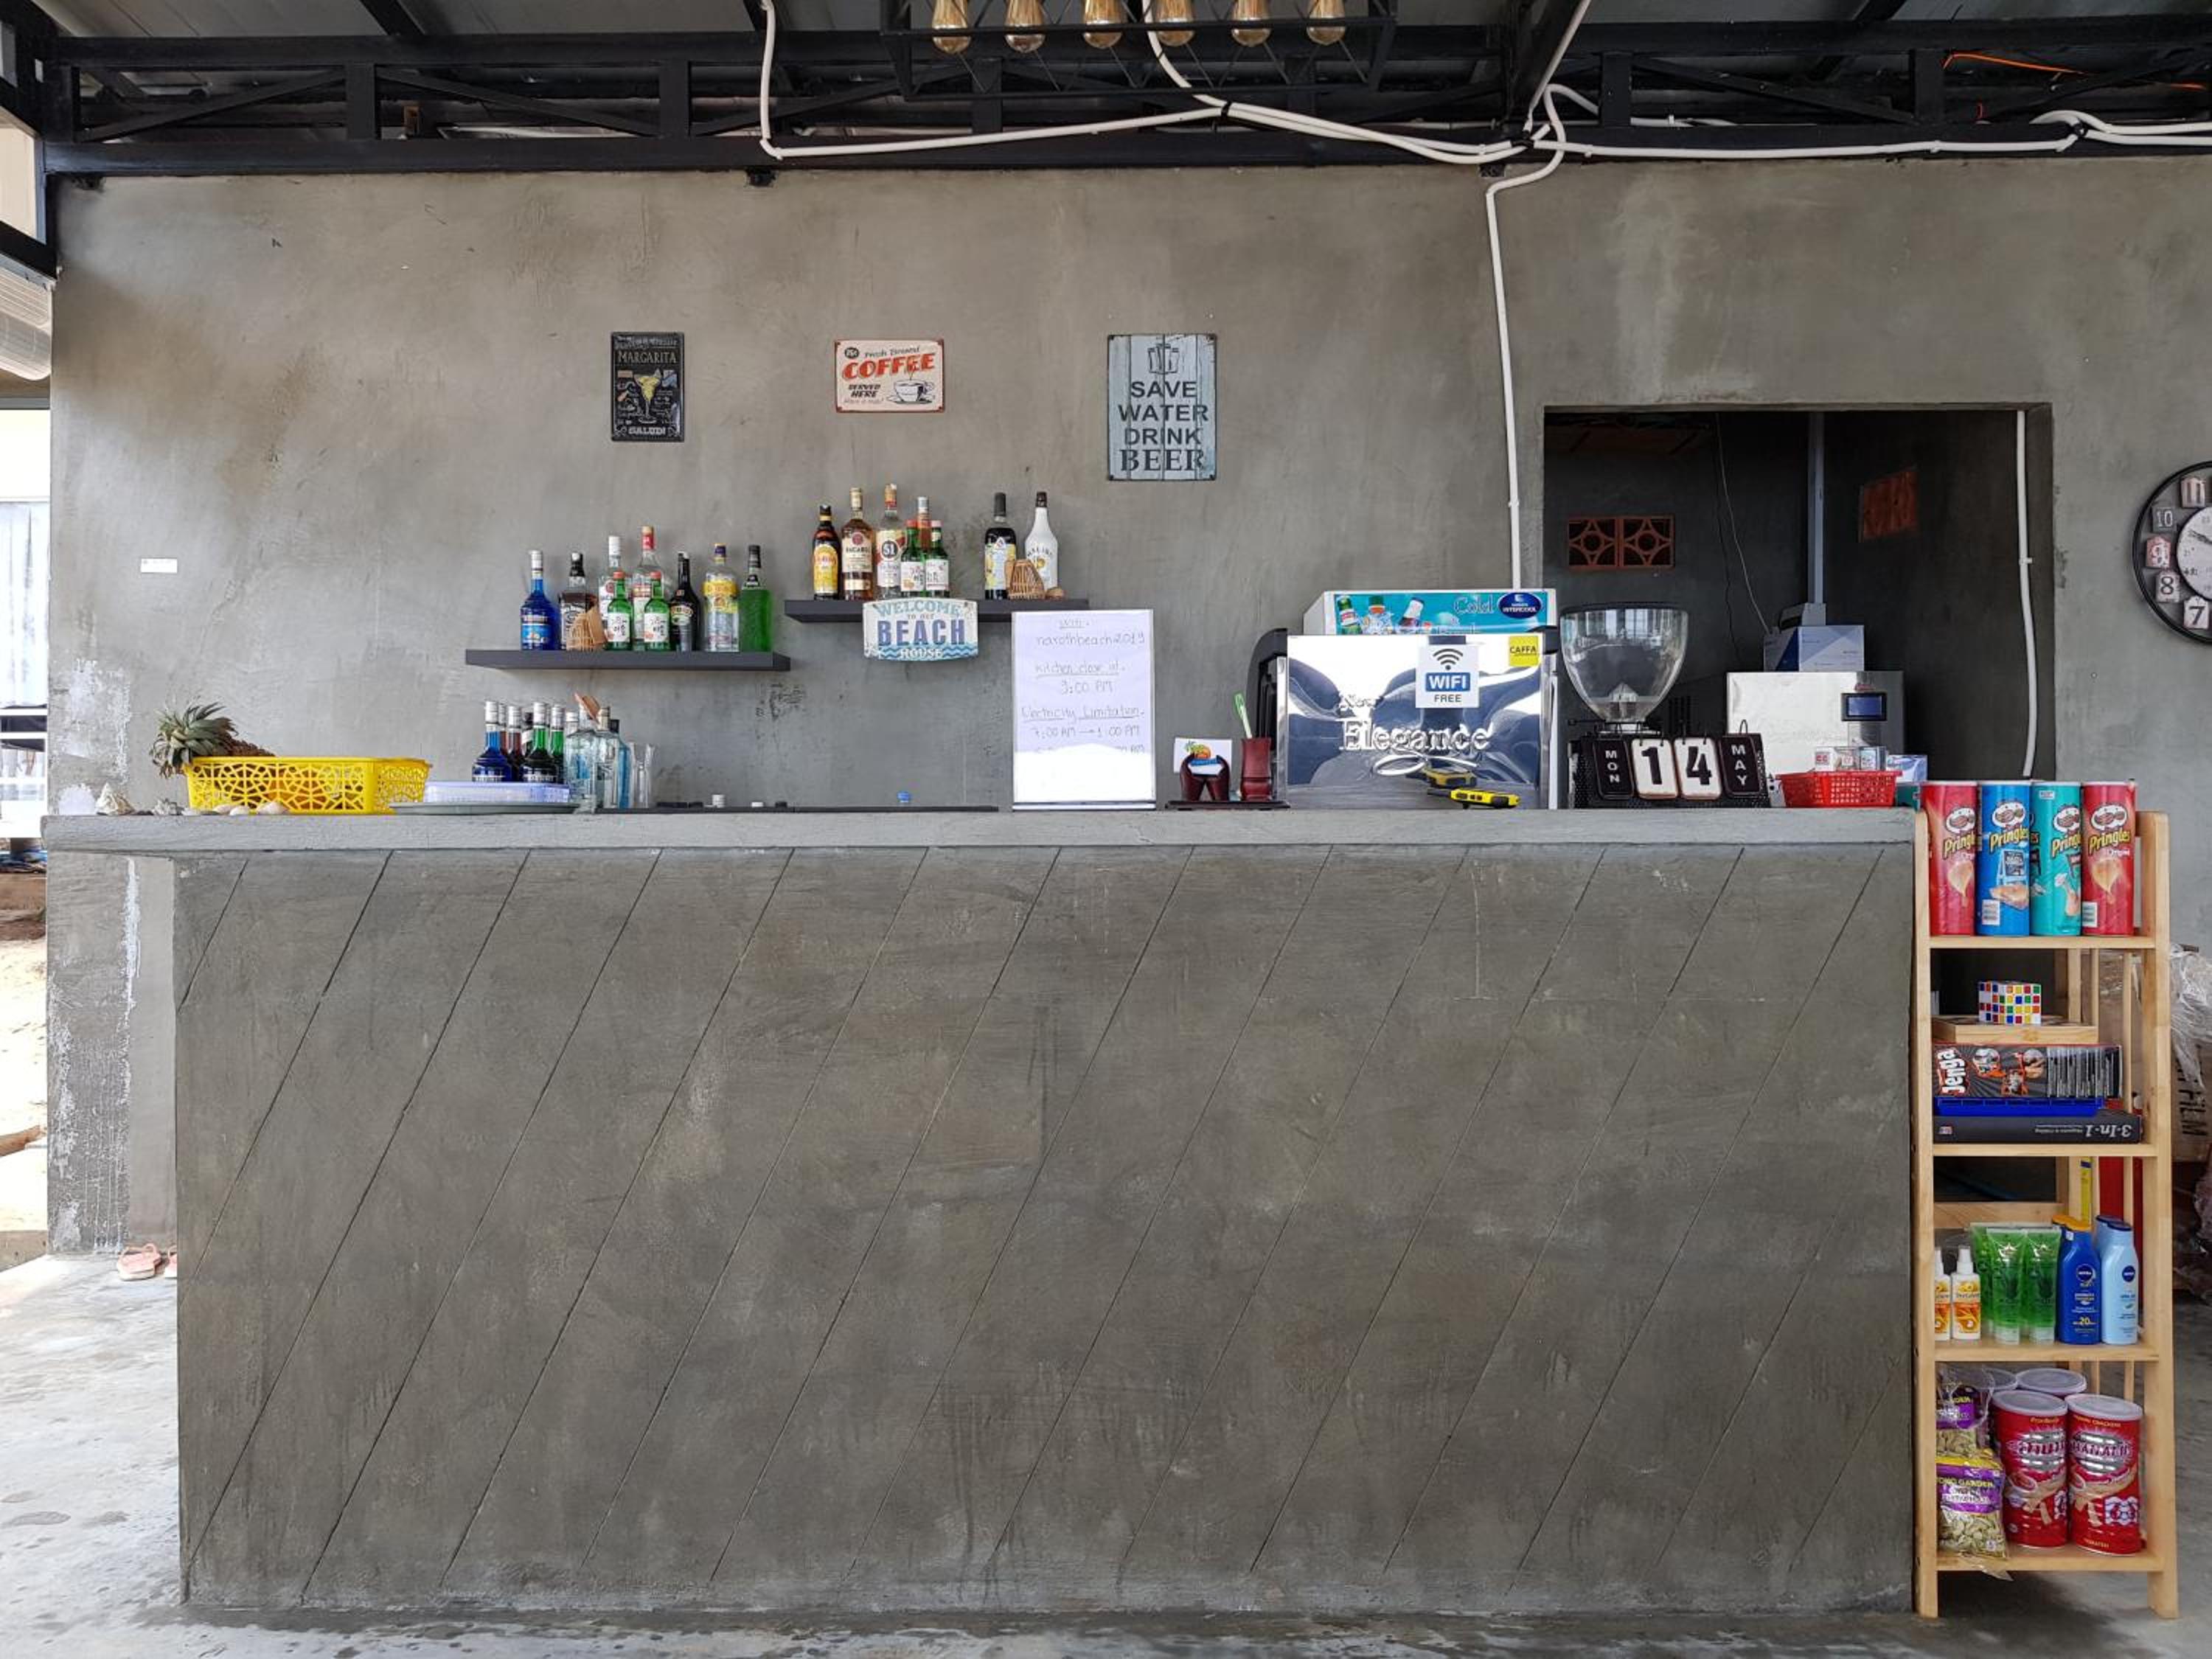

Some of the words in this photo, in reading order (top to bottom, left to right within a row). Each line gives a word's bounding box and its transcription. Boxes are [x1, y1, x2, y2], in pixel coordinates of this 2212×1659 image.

[618, 351, 677, 364] MARGARITA
[842, 352, 936, 380] COFFEE
[1130, 381, 1197, 398] SAVE
[1118, 405, 1208, 421] WATER
[1124, 428, 1203, 445] DRINK
[1120, 449, 1203, 471] BEER
[2157, 510, 2173, 527] 10
[2160, 577, 2174, 595] 8
[877, 600, 961, 616] WELCOME
[1453, 594, 1493, 613] Cold
[2188, 605, 2205, 625] 7
[877, 619, 965, 645] BEACH
[900, 648, 944, 658] HOUSE
[1428, 675, 1467, 689] WIFI
[1434, 694, 1462, 703] FREE
[1340, 717, 1493, 752] Elegance
[1605, 750, 1620, 783] MON
[1731, 745, 1747, 785] MAY
[1943, 831, 1976, 860] Pringl
[2088, 828, 2131, 855] Pringles
[1938, 1048, 1966, 1094] Jenga
